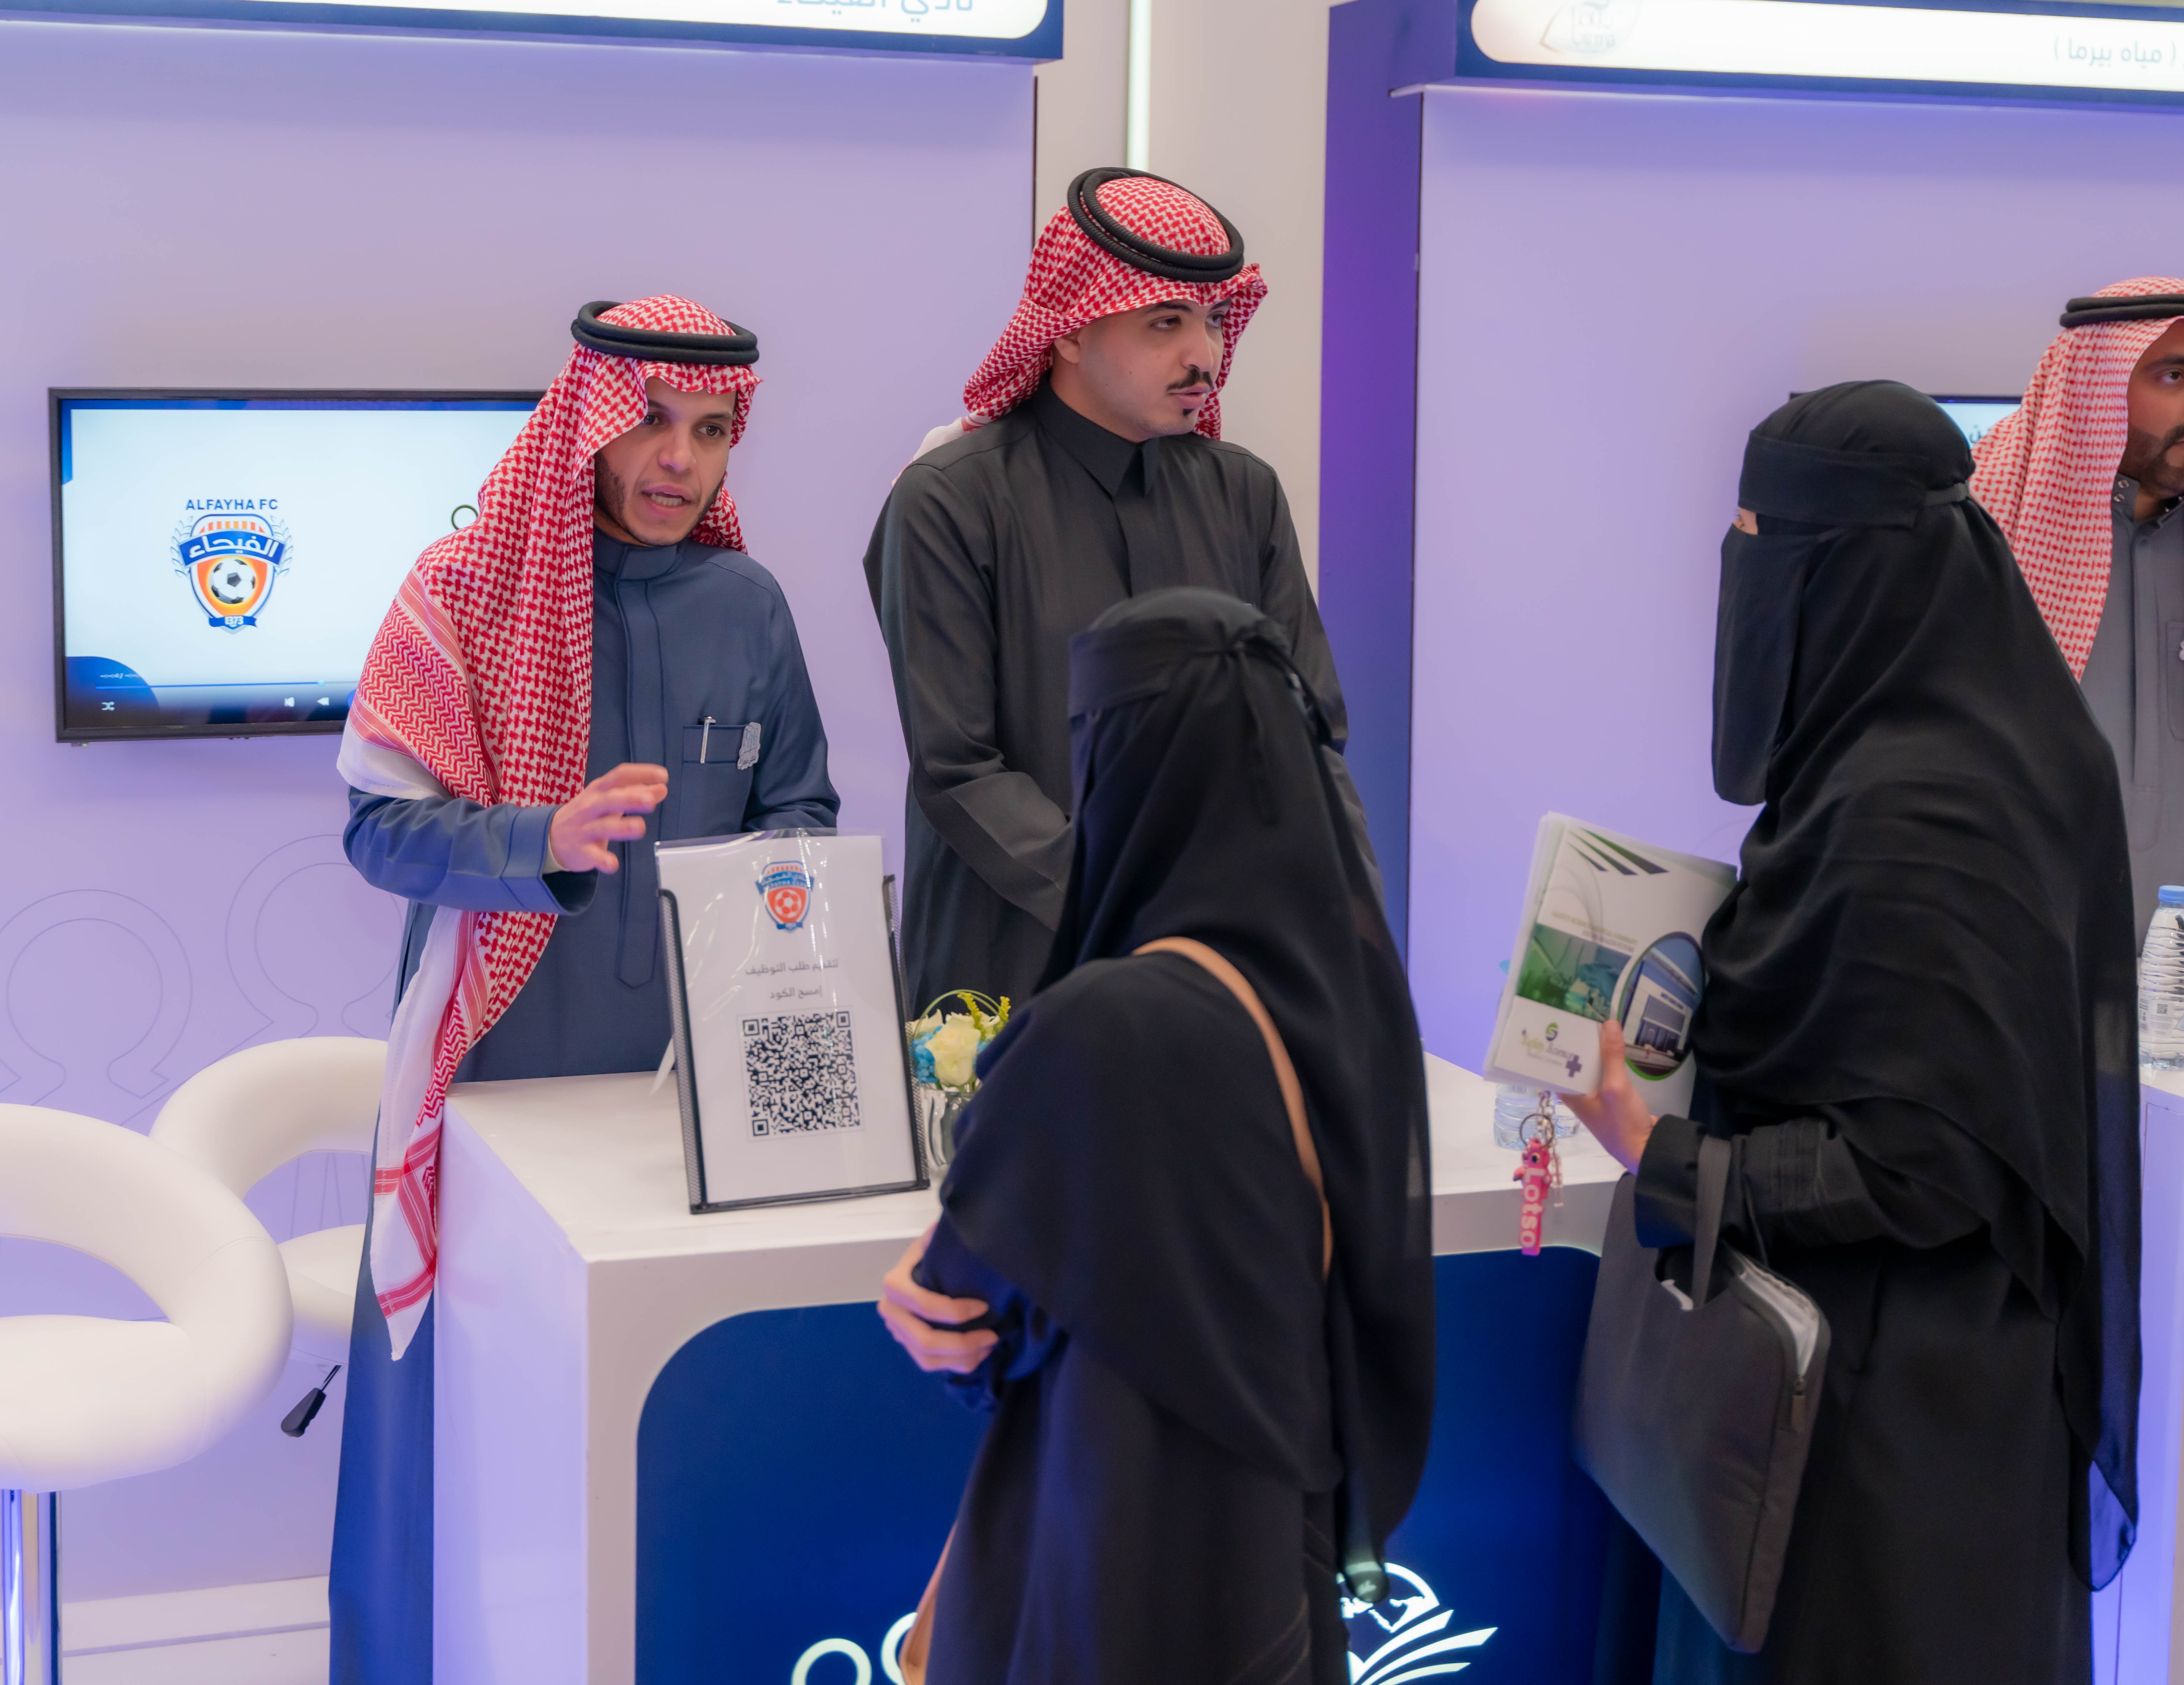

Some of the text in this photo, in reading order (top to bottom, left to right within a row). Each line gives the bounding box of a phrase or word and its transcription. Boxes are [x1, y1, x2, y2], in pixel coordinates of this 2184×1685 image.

[2120, 40, 2162, 68] مياه
[186, 499, 278, 510] ALFAYHA FC
[189, 535, 280, 559] الفيحاء
[225, 616, 244, 625] 1373
[788, 960, 810, 973] طلب
[1520, 1168, 1545, 1248] Lotso
